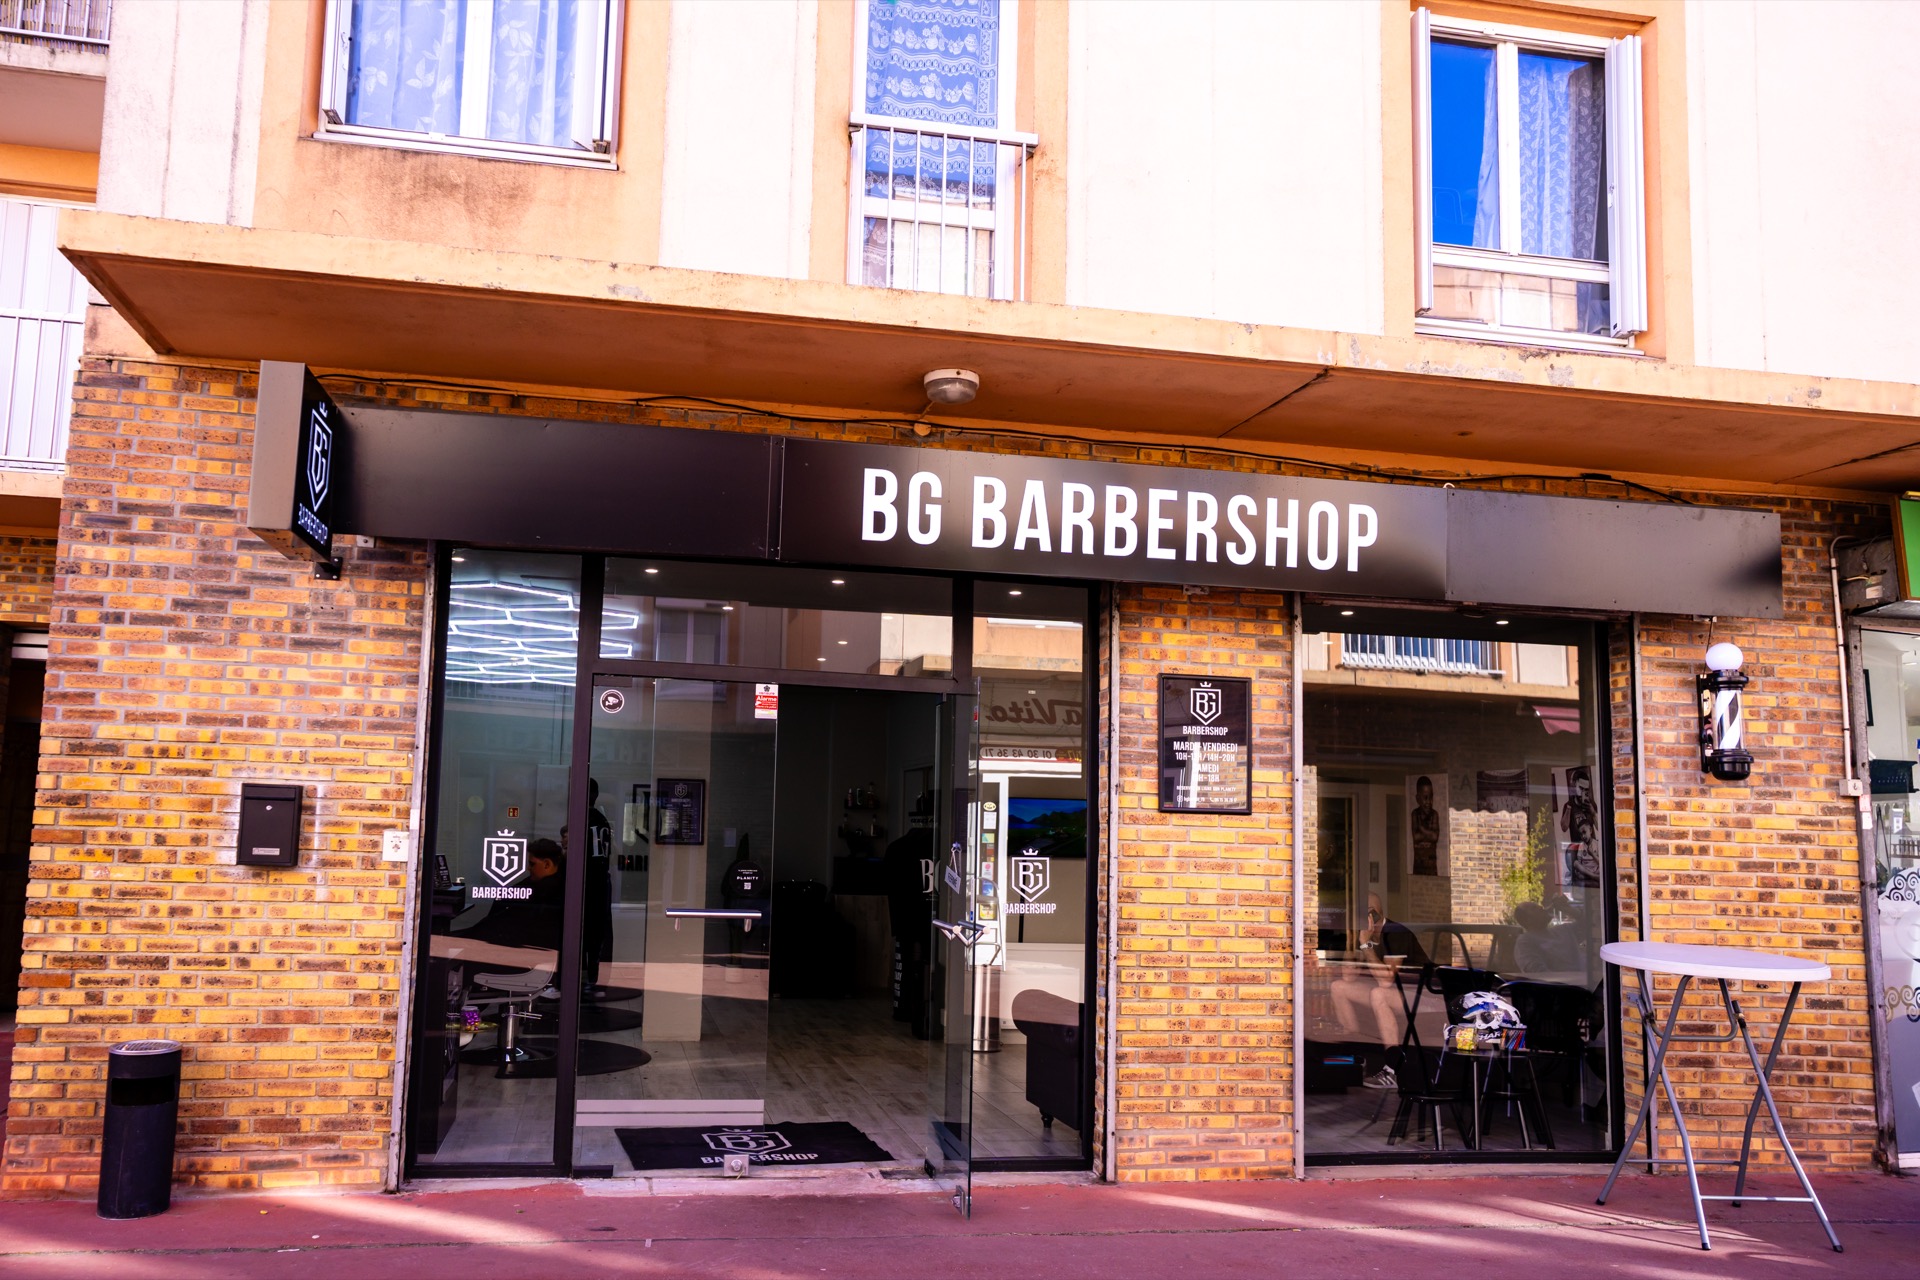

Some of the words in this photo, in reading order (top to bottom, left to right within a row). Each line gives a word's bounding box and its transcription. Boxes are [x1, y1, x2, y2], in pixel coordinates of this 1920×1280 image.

[861, 467, 943, 546] BG
[971, 475, 1378, 573] BARBERSHOP
[1196, 692, 1216, 719] BG
[1182, 725, 1229, 736] BARBERSHOP
[491, 843, 519, 877] BG
[1018, 862, 1043, 894] BG
[472, 886, 533, 899] BARBERSHOP
[1003, 903, 1057, 914] BARBERSHOP
[701, 1152, 819, 1165] BAERSHOP
